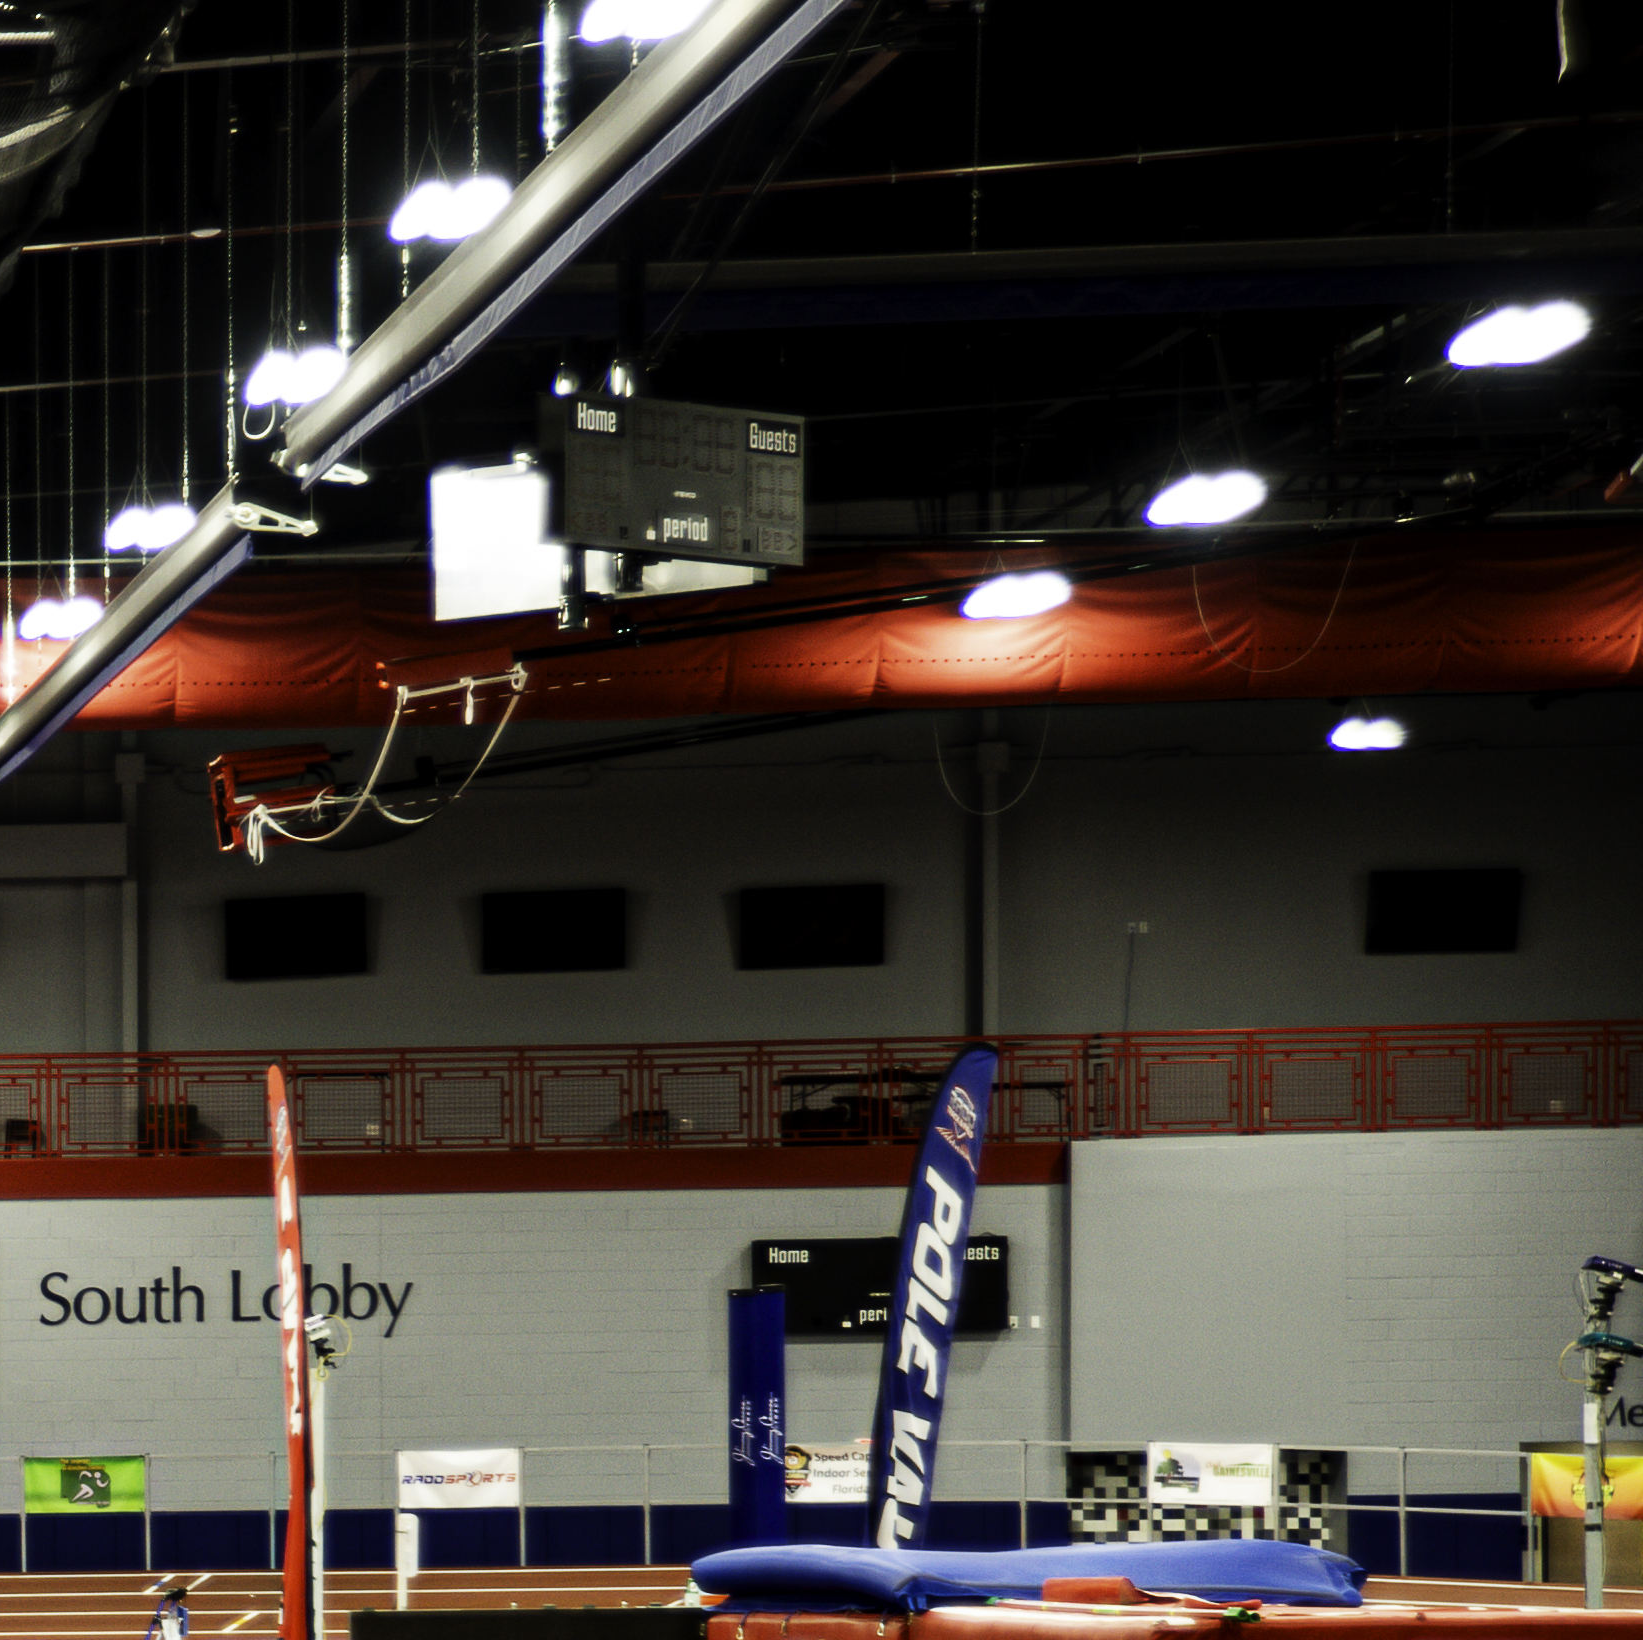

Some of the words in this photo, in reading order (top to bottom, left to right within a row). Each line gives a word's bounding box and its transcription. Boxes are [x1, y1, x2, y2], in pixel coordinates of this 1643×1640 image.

[577, 401, 618, 434] Home
[749, 422, 797, 454] Guests
[662, 516, 709, 543] period
[768, 1246, 809, 1264] Home
[963, 1244, 1000, 1262] ests
[896, 1165, 963, 1399] POLE
[38, 1265, 205, 1326] South
[231, 1262, 414, 1338] Lobby
[859, 1304, 888, 1325] peri
[814, 1453, 849, 1463] Speed
[813, 1469, 851, 1478] Indoor
[876, 1409, 932, 1549] VAU
